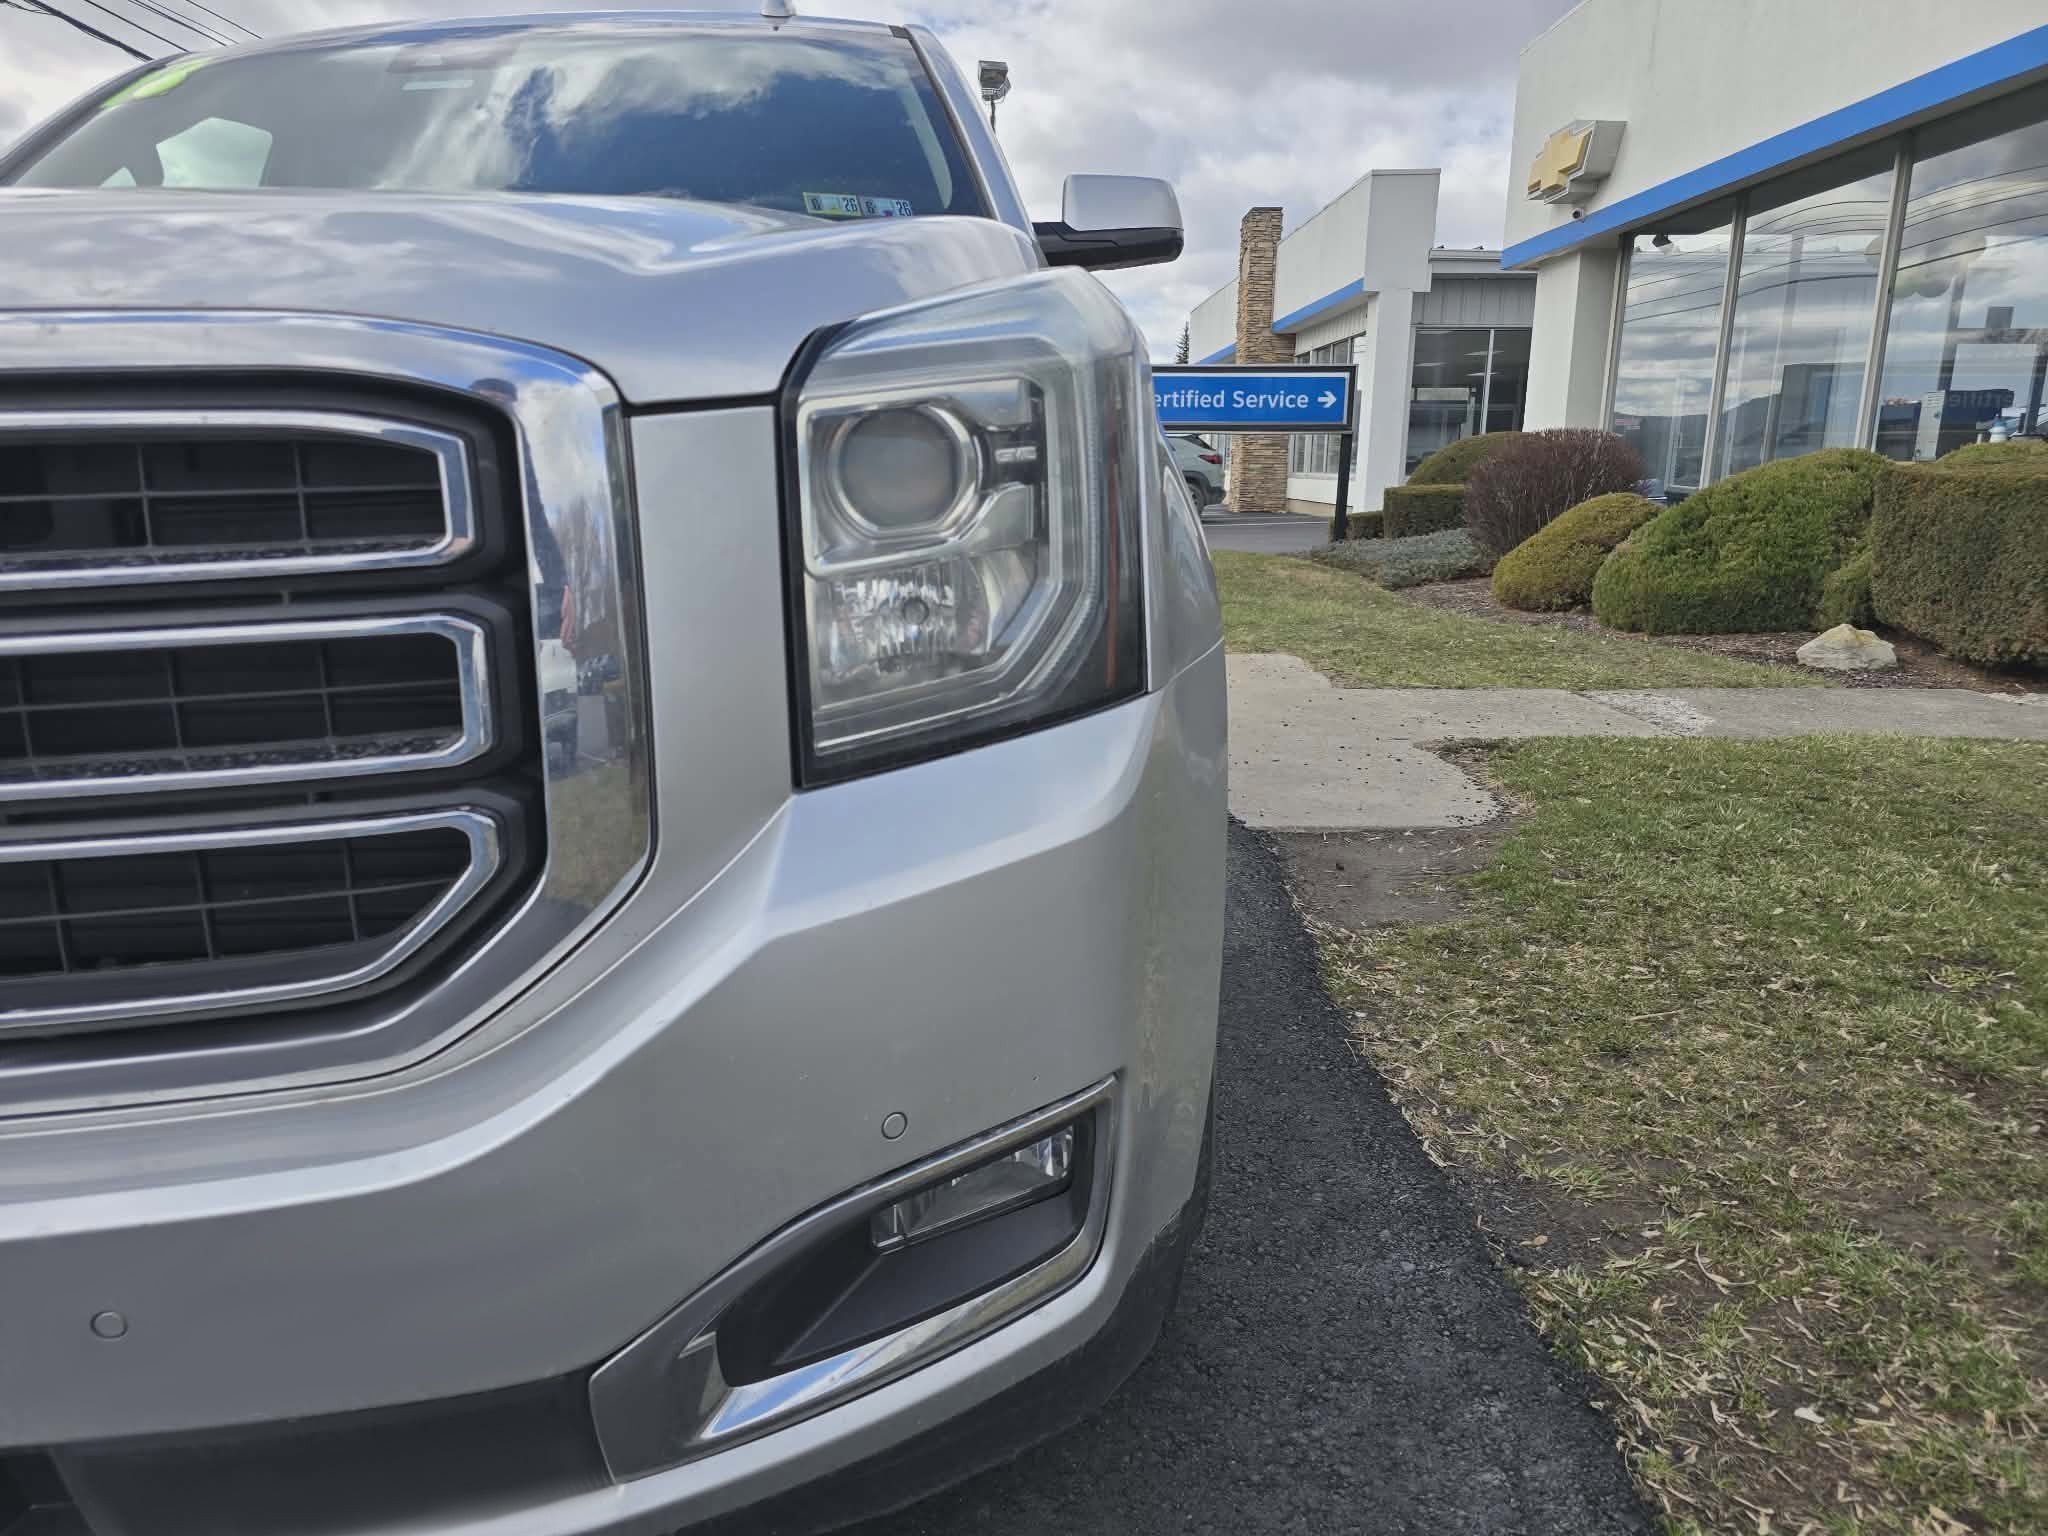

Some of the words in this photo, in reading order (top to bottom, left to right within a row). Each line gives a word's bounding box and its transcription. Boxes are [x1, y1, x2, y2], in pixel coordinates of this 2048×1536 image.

[842, 198, 858, 212] 26
[896, 200, 912, 216] 26
[1232, 390, 1309, 409] Service
[995, 446, 1037, 463] GMC
